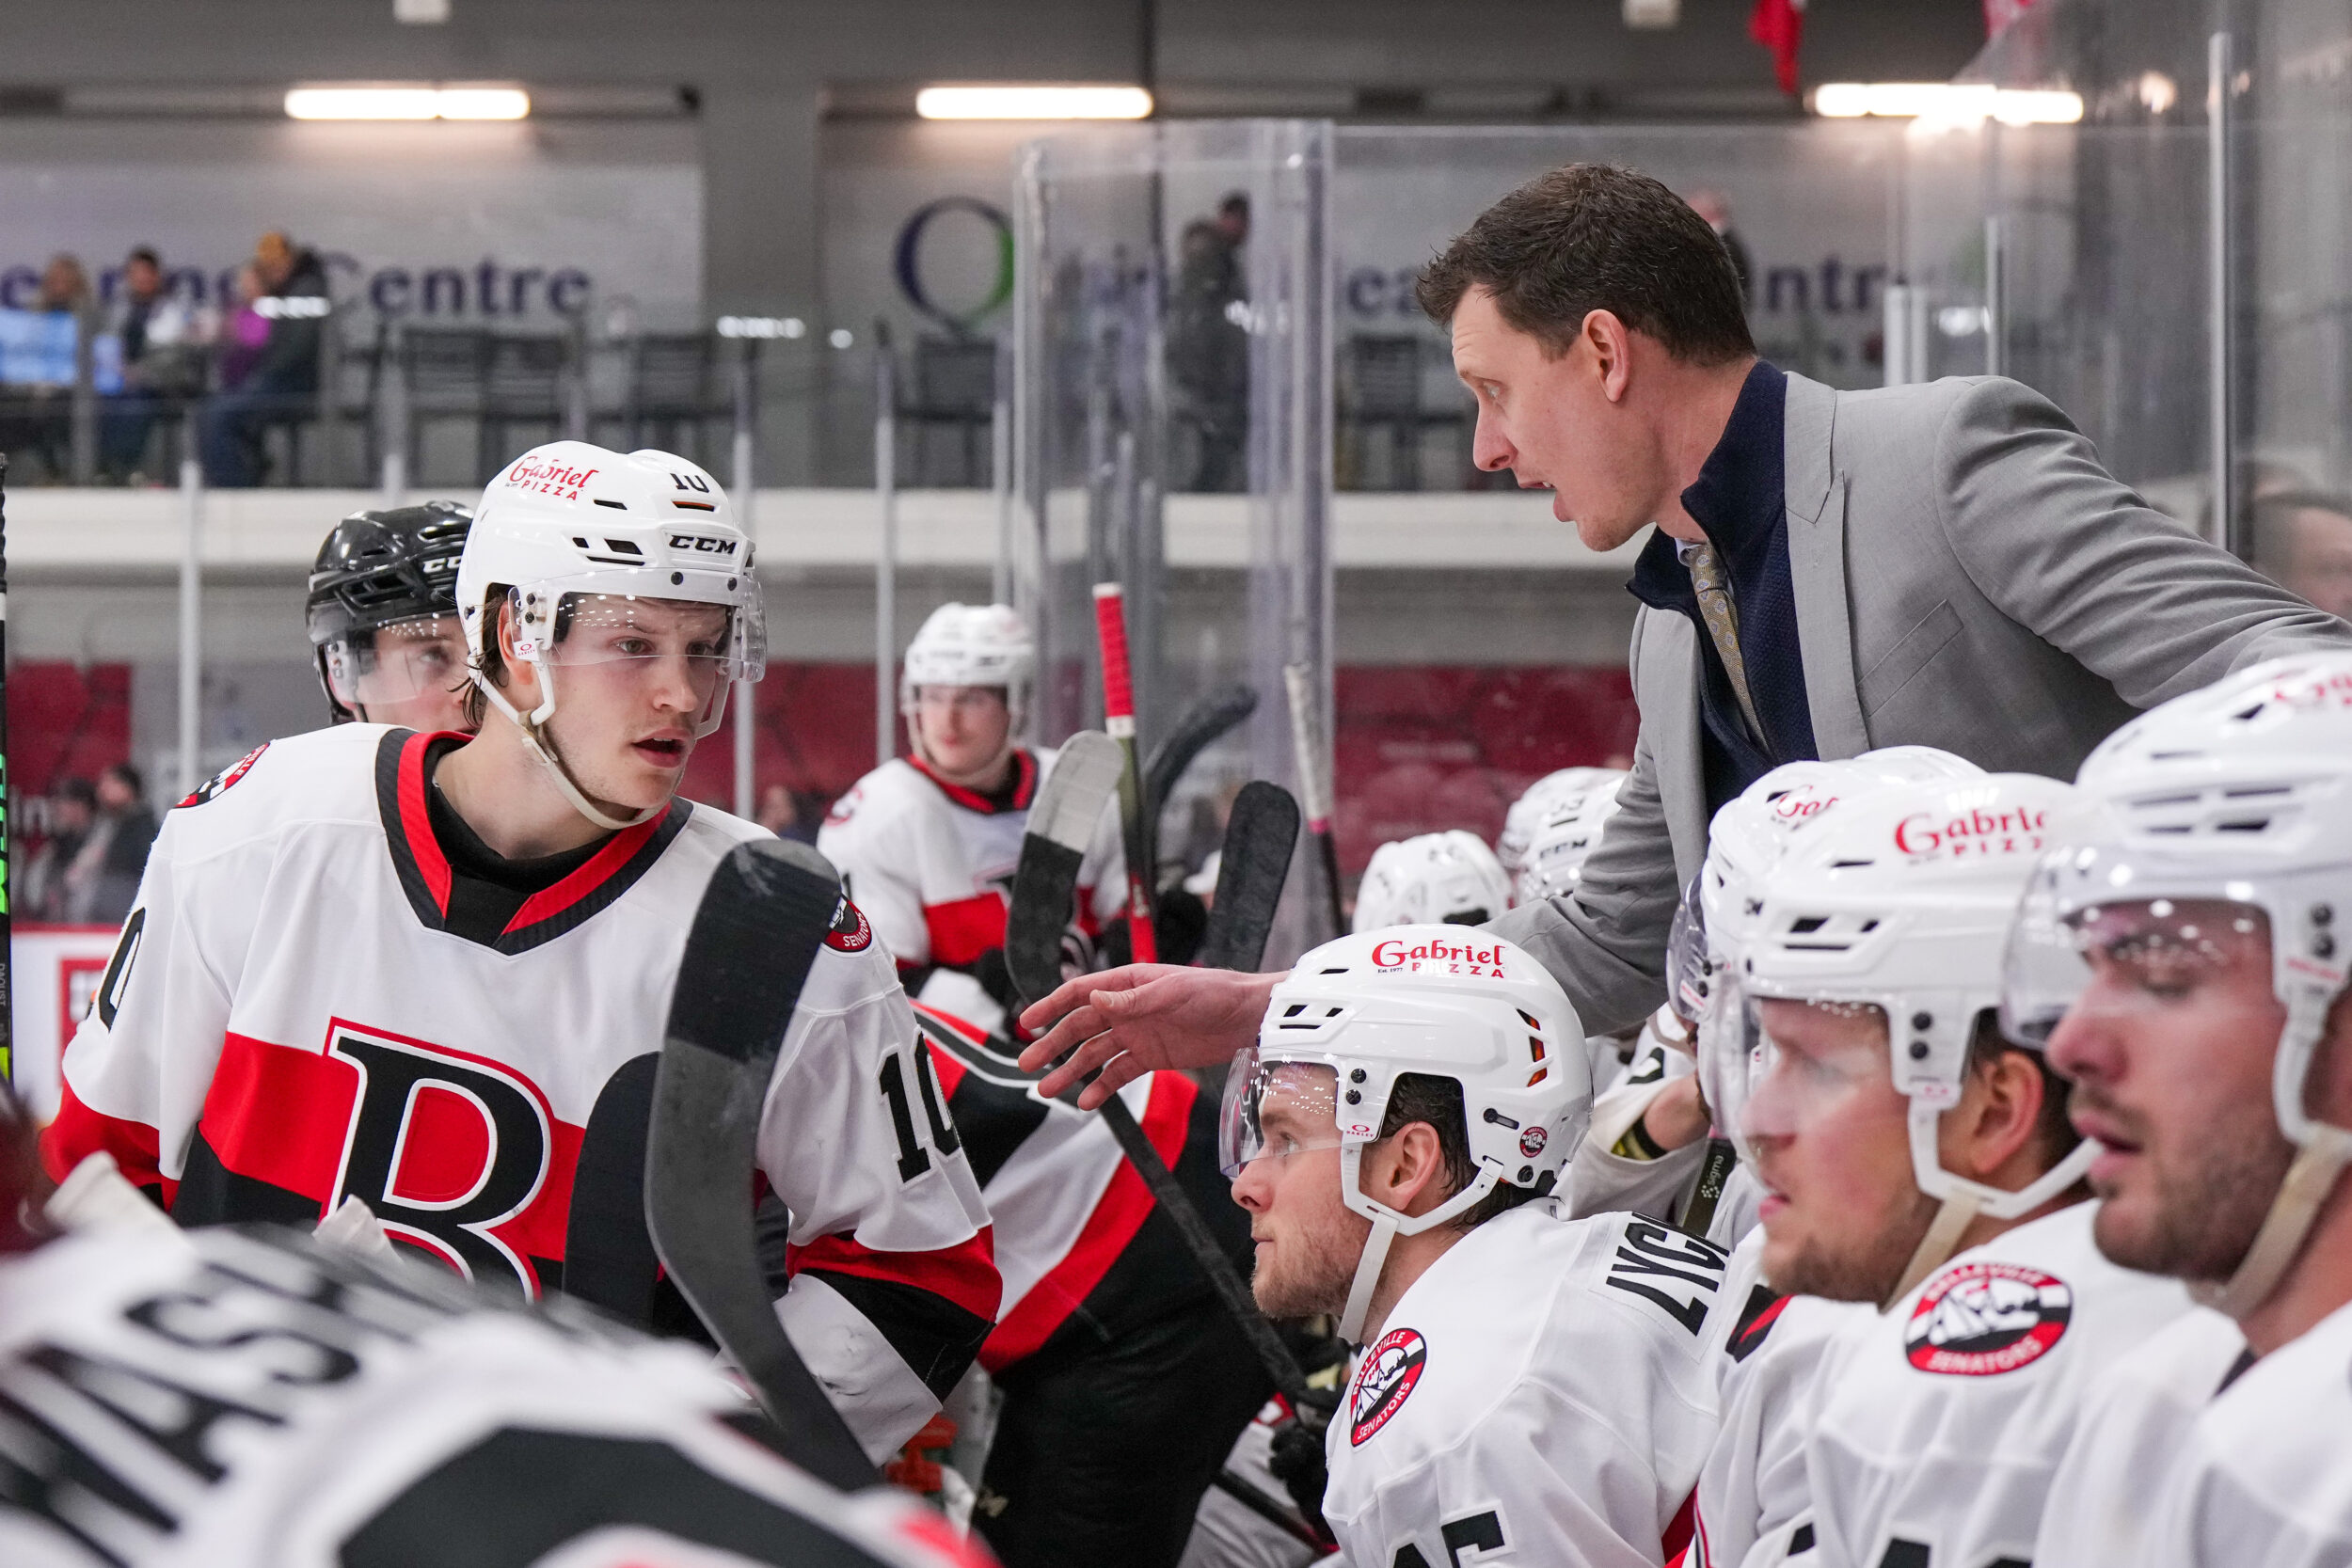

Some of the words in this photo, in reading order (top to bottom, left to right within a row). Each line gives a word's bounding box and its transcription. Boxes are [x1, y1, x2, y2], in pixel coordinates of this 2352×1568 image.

[509, 455, 600, 489] Gabriel
[521, 479, 578, 501] PIZZA
[668, 534, 738, 555] CCM
[422, 555, 462, 574] CC
[1371, 939, 1506, 968] Gabriel
[1411, 962, 1505, 979] PZZA
[878, 1027, 961, 1185] 10
[322, 1016, 557, 1304] B
[1357, 1381, 1411, 1440] SENATORS
